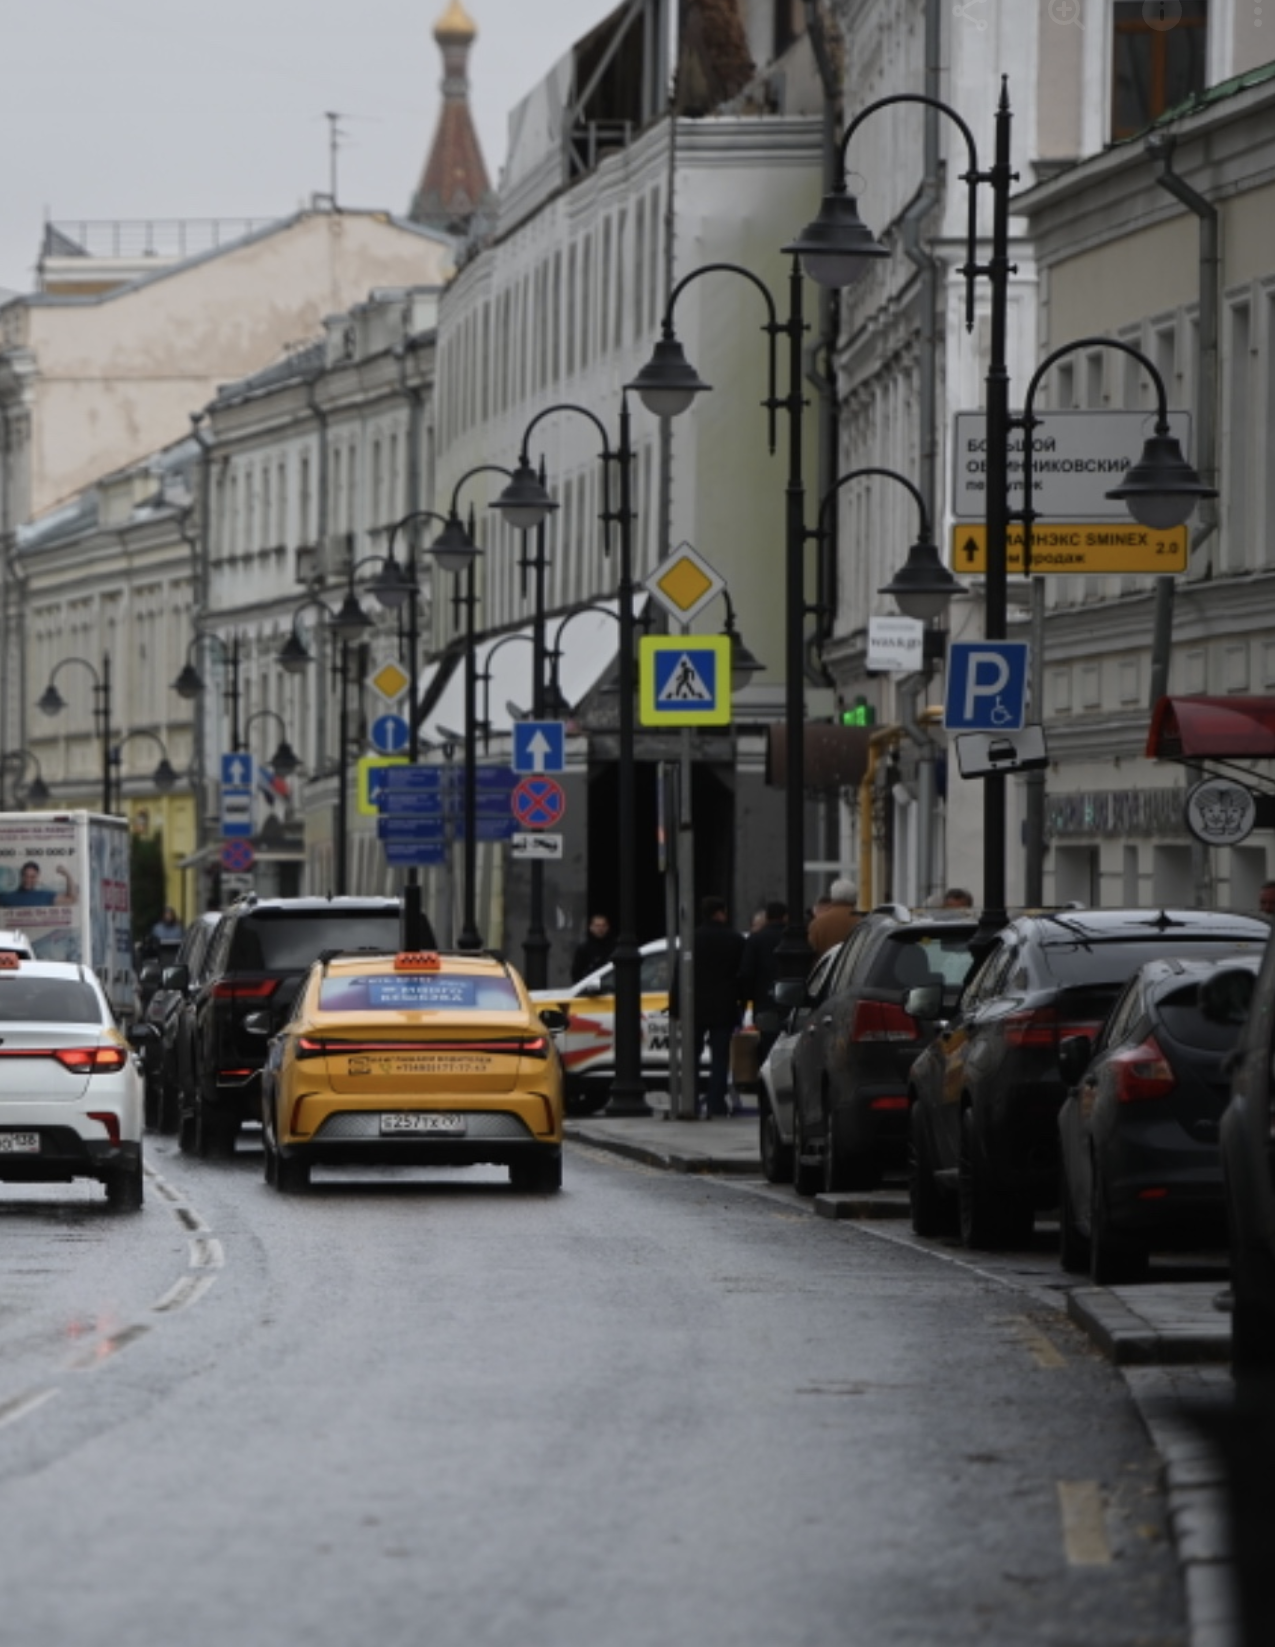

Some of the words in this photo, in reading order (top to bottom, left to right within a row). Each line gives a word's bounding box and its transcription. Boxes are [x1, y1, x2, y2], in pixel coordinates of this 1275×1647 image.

[968, 436, 1055, 452] БОЬШОЙ
[1085, 532, 1148, 546] SMINEX
[1028, 553, 1086, 567] родаж
[964, 652, 1009, 720] P
